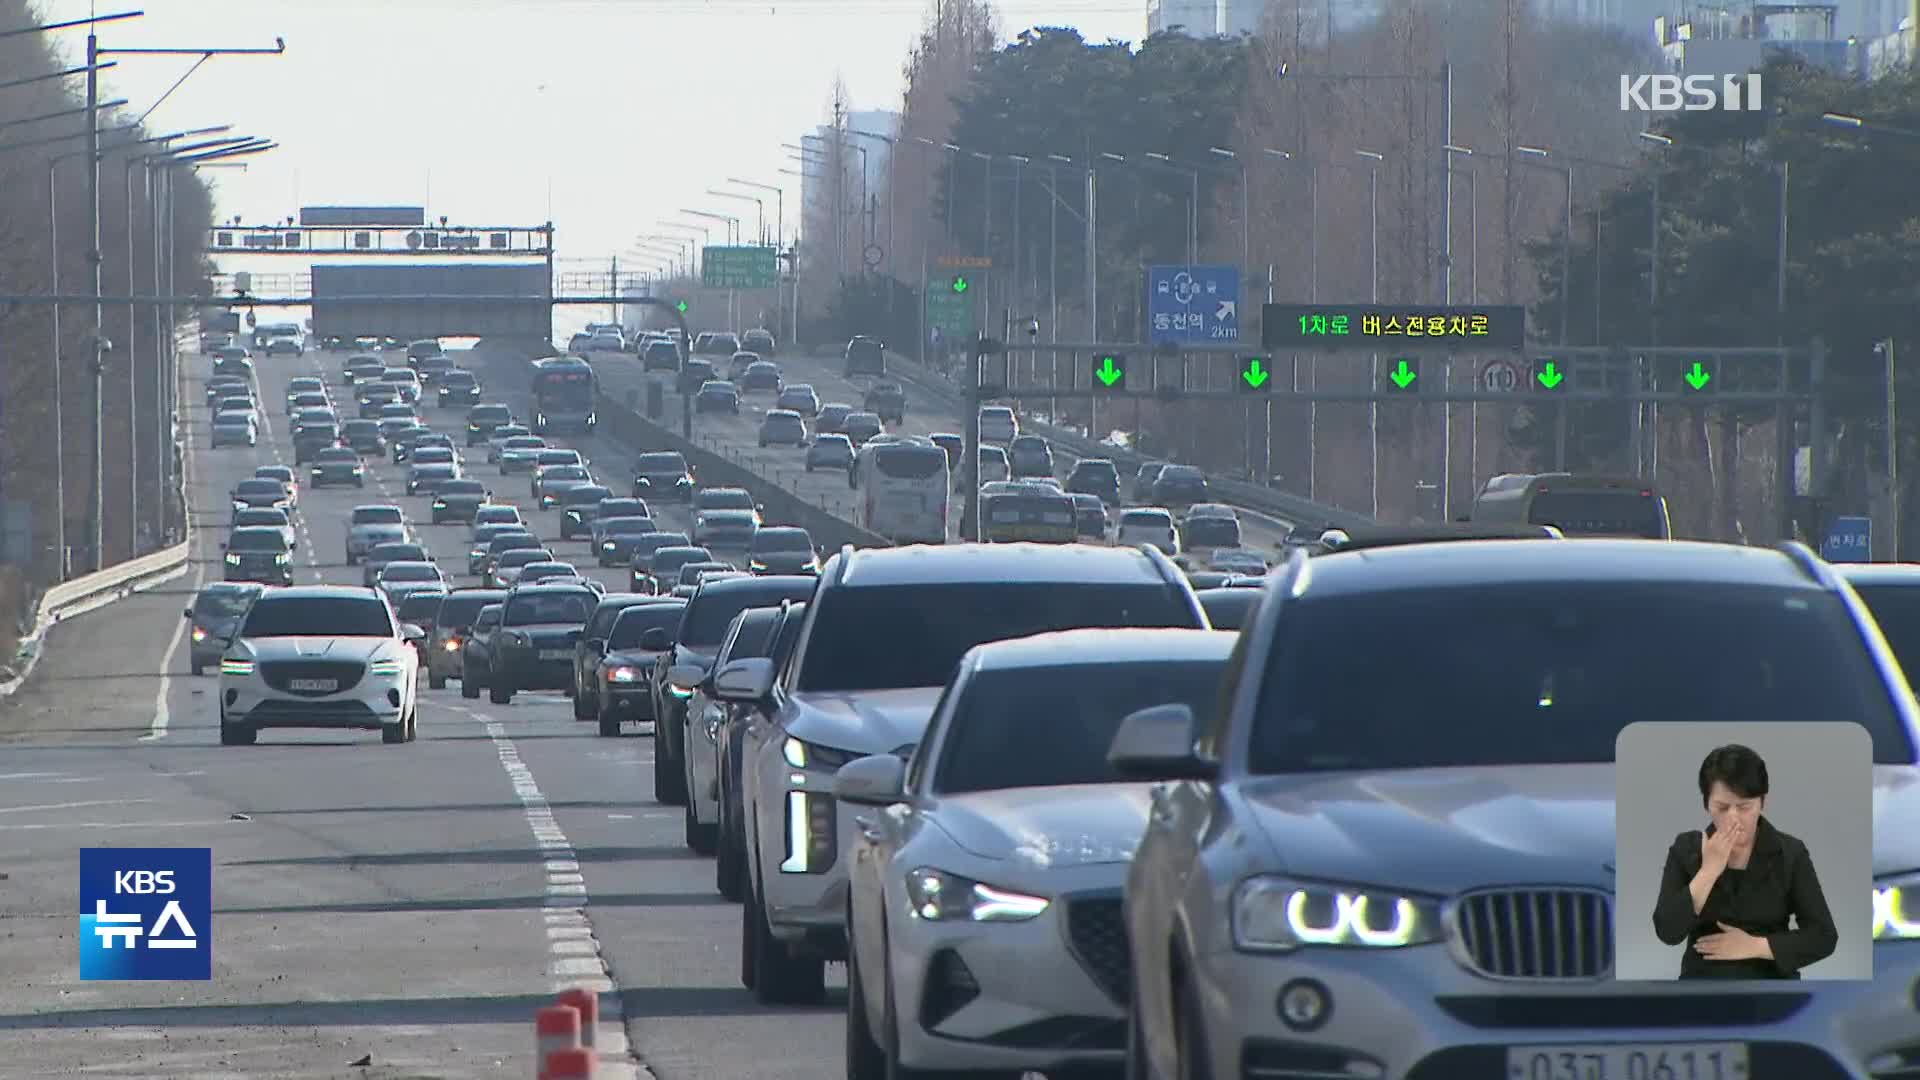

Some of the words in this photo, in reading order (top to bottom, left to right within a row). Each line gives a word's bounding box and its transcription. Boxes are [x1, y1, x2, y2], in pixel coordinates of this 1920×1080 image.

[1154, 313, 1204, 332] 동천역
[1211, 325, 1238, 338] 2km
[1298, 315, 1350, 335] 1차로
[1362, 315, 1489, 337] 버스전용차로
[1627, 1051, 1722, 1080] 0611
